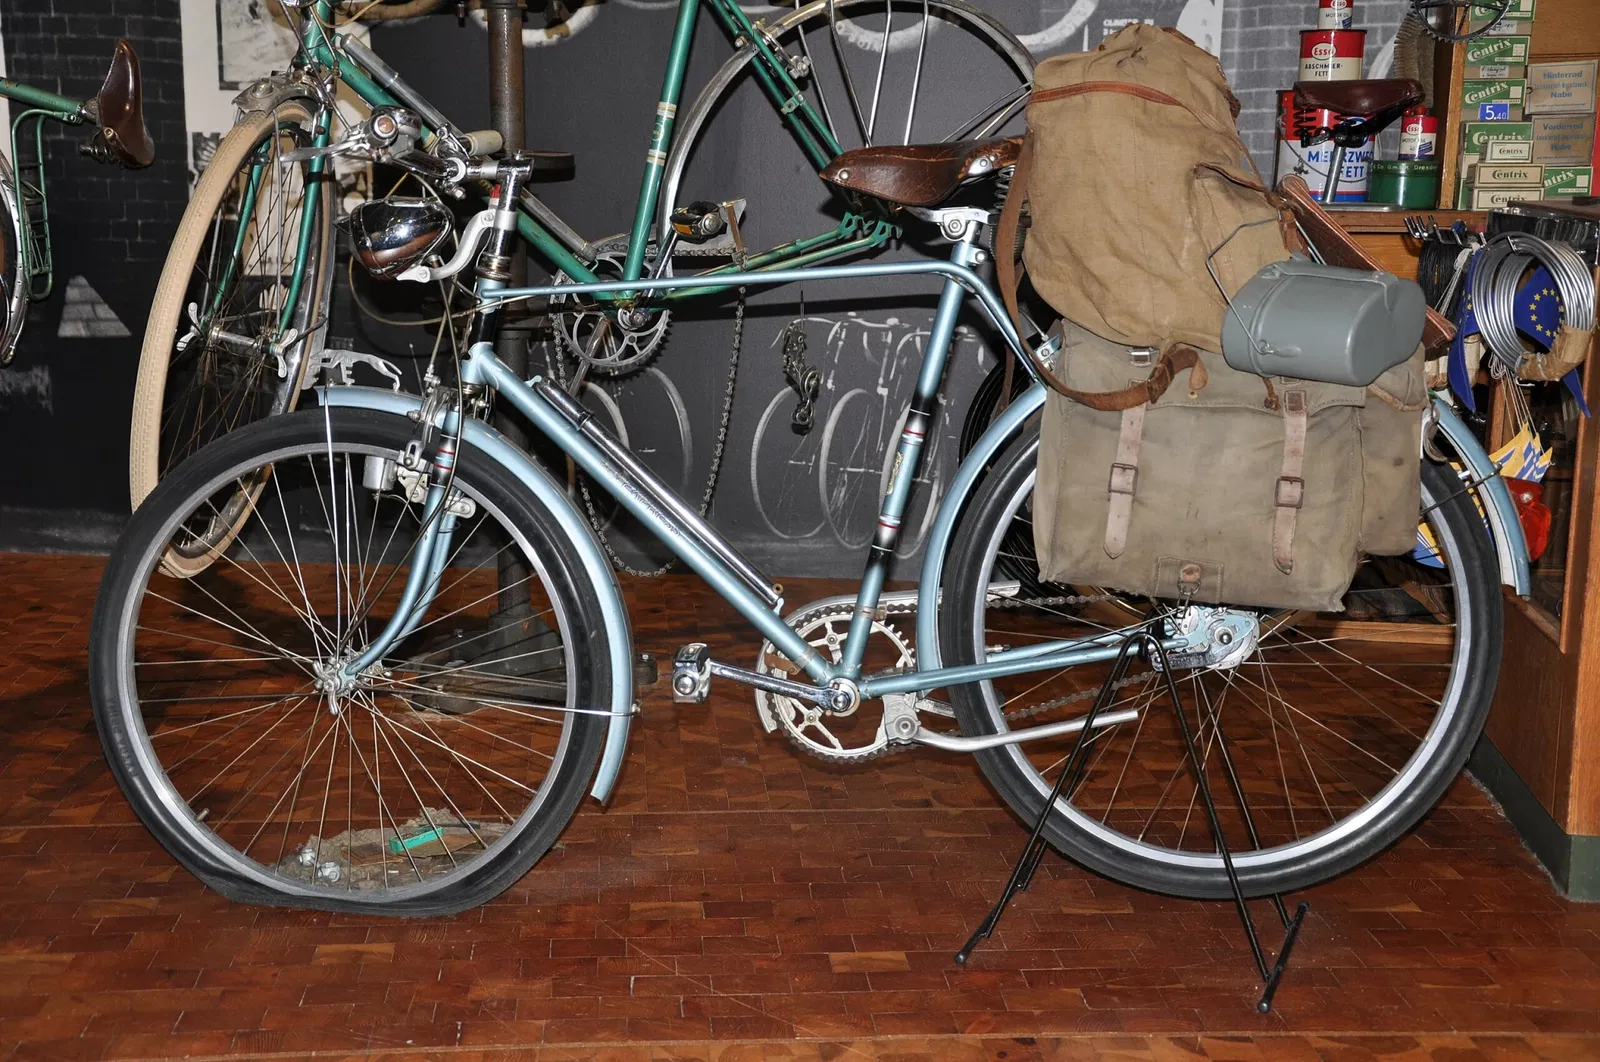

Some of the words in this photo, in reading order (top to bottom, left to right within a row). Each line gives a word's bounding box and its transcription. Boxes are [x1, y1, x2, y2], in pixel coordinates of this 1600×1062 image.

[1313, 47, 1334, 56] Esso
[1467, 39, 1512, 62] Centrix
[1304, 62, 1344, 70] ABSCHMER-
[1464, 81, 1510, 104] Centrix
[1485, 105, 1507, 120] 5.40
[1472, 131, 1526, 146] Centrix
[1498, 147, 1524, 155] Centrix
[1491, 169, 1529, 180] Centrix
[1543, 170, 1575, 188] ntrix
